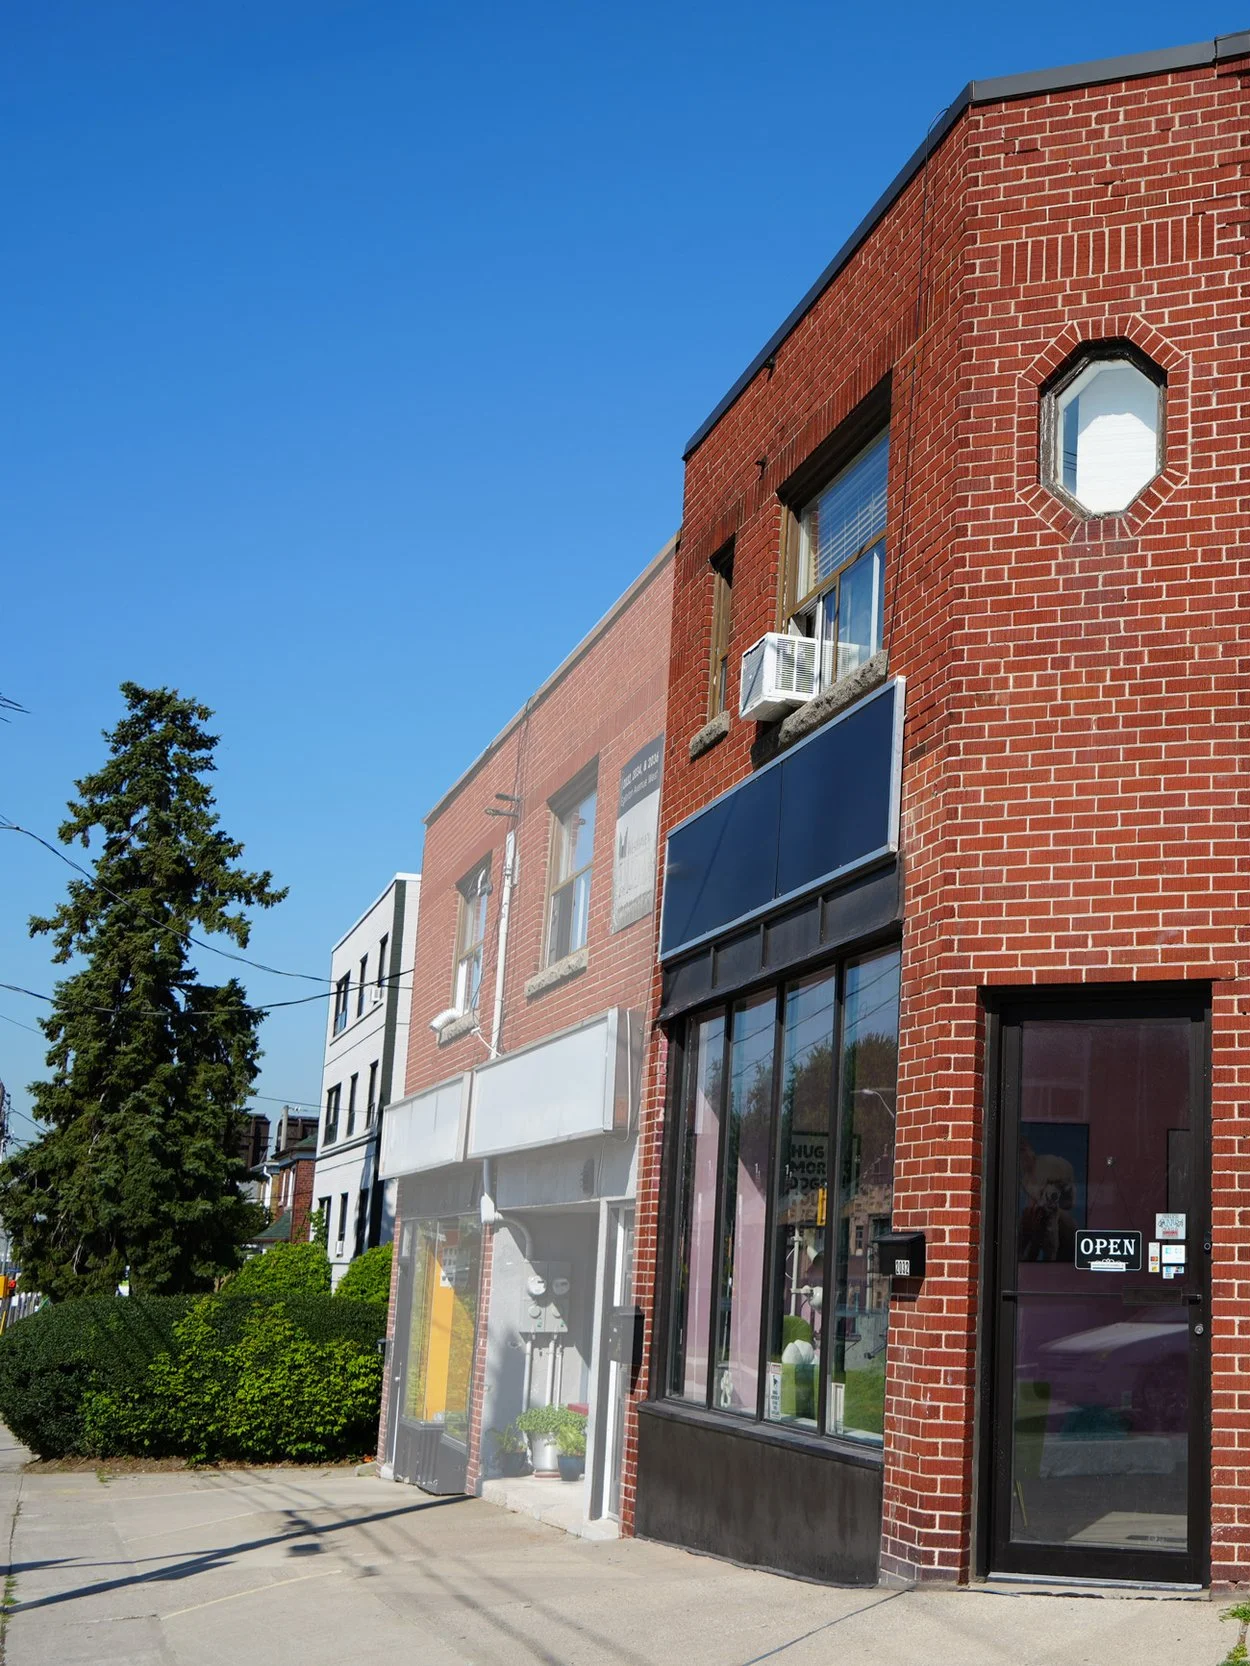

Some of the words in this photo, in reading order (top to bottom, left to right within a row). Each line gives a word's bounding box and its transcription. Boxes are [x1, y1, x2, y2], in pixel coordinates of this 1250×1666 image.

[790, 1144, 825, 1159] HUG
[789, 1161, 827, 1175] MOR
[1080, 1238, 1136, 1255] OPEN
[895, 1260, 910, 1275] 2032
